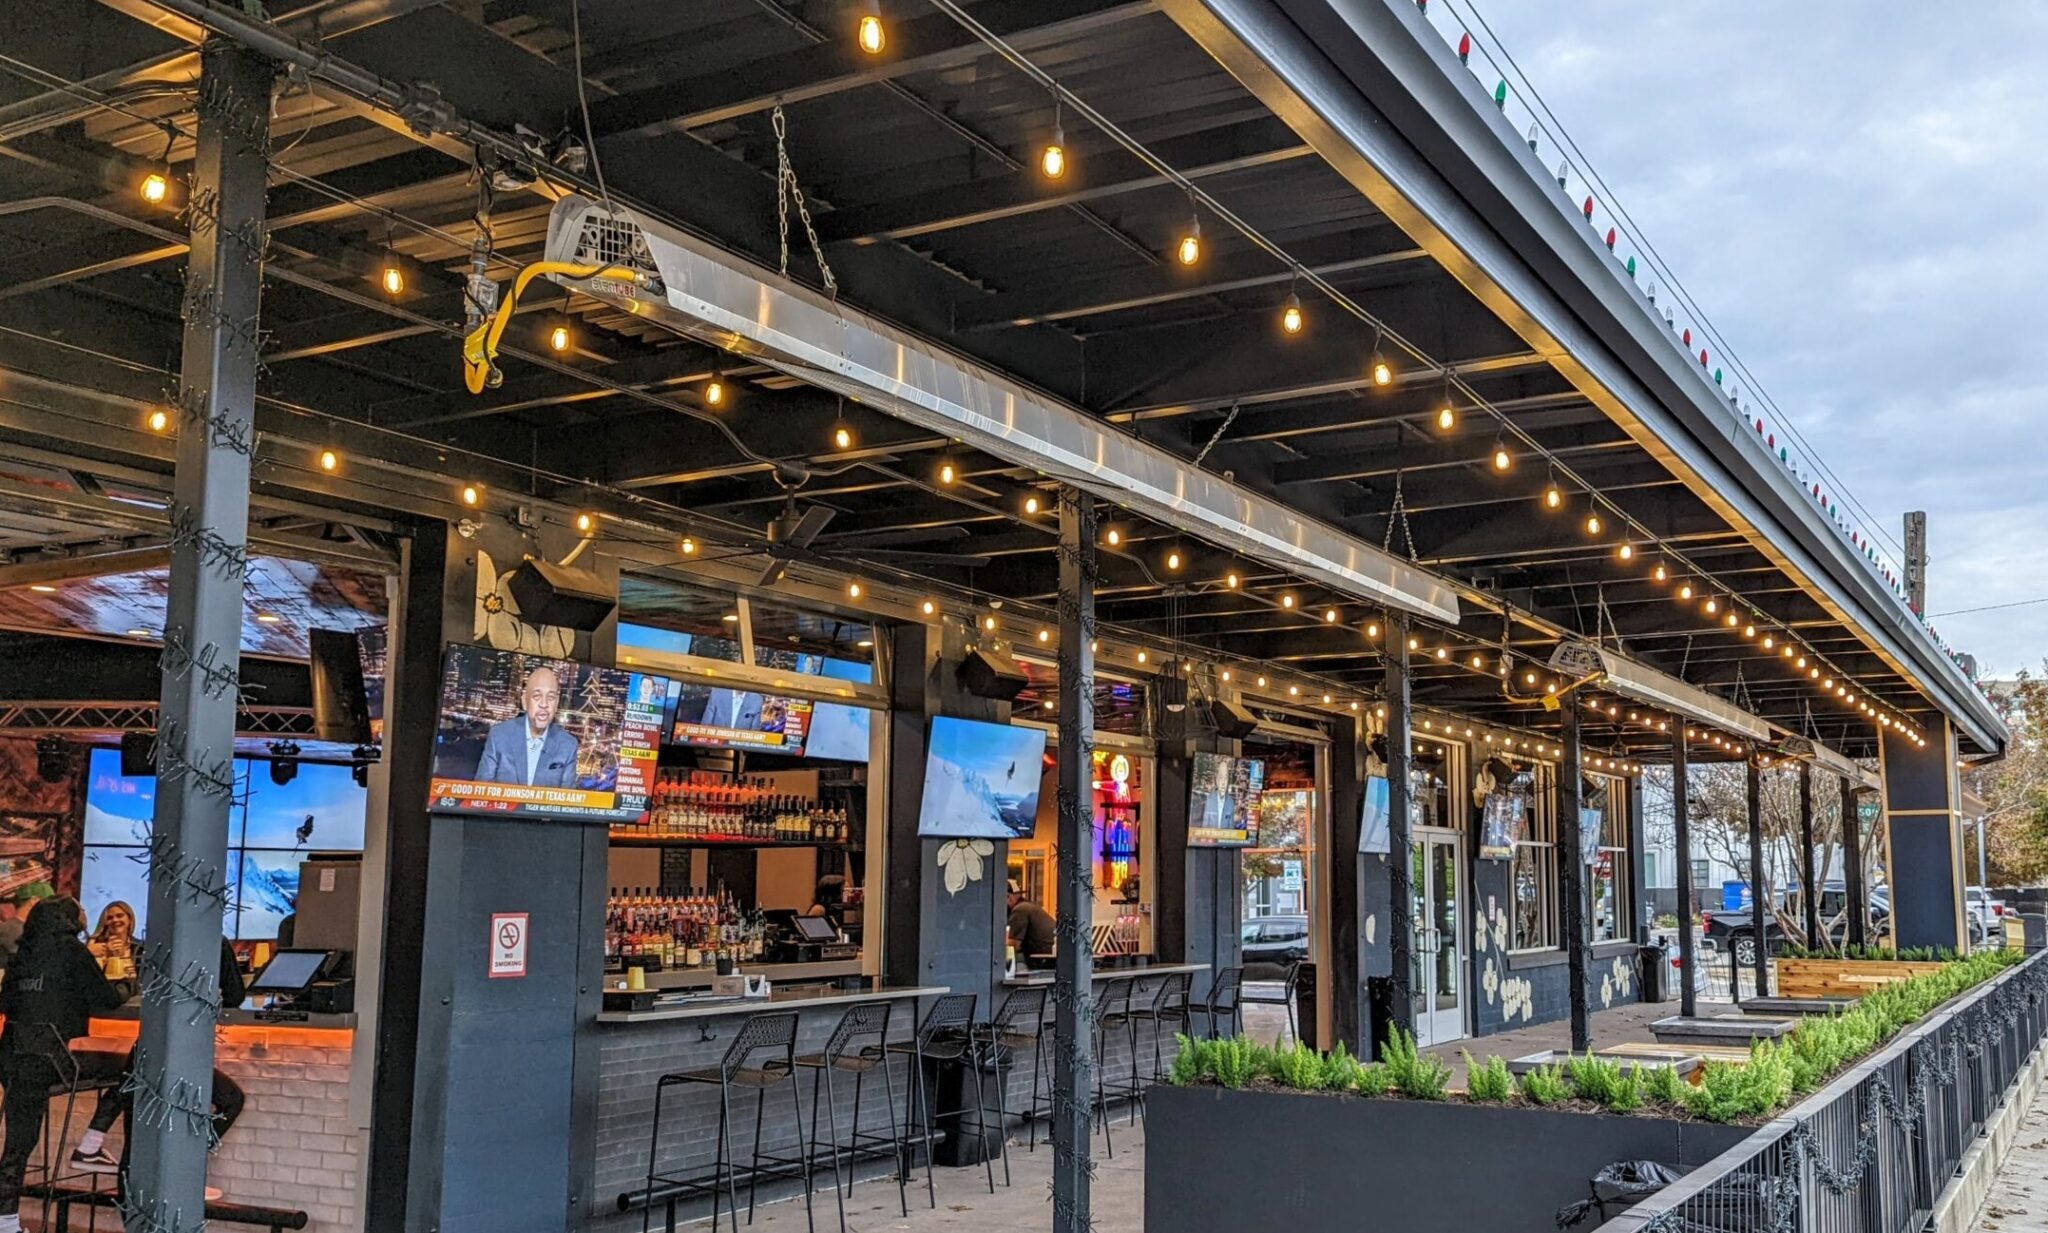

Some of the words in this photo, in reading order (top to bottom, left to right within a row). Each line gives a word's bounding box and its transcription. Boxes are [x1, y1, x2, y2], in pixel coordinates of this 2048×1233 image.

[626, 712, 653, 721] RUNDOWN
[624, 721, 643, 730] PEACH
[643, 723, 658, 732] BOWL
[623, 730, 645, 740] ERRORS
[621, 748, 638, 756] TEXAS
[618, 766, 641, 775] PISTONS
[617, 775, 644, 784] BAHAMAS
[451, 783, 473, 795] GOOD
[474, 785, 487, 796] FIT
[487, 786, 502, 797] FOR
[503, 788, 535, 800] JOHNSON
[535, 790, 545, 801] AT
[546, 791, 566, 802] TEXAS
[615, 784, 632, 793] CURE
[631, 786, 647, 795] BOWL
[621, 794, 647, 804] TRULY
[470, 800, 489, 808] NEXT
[494, 960, 522, 968] SMOKING
